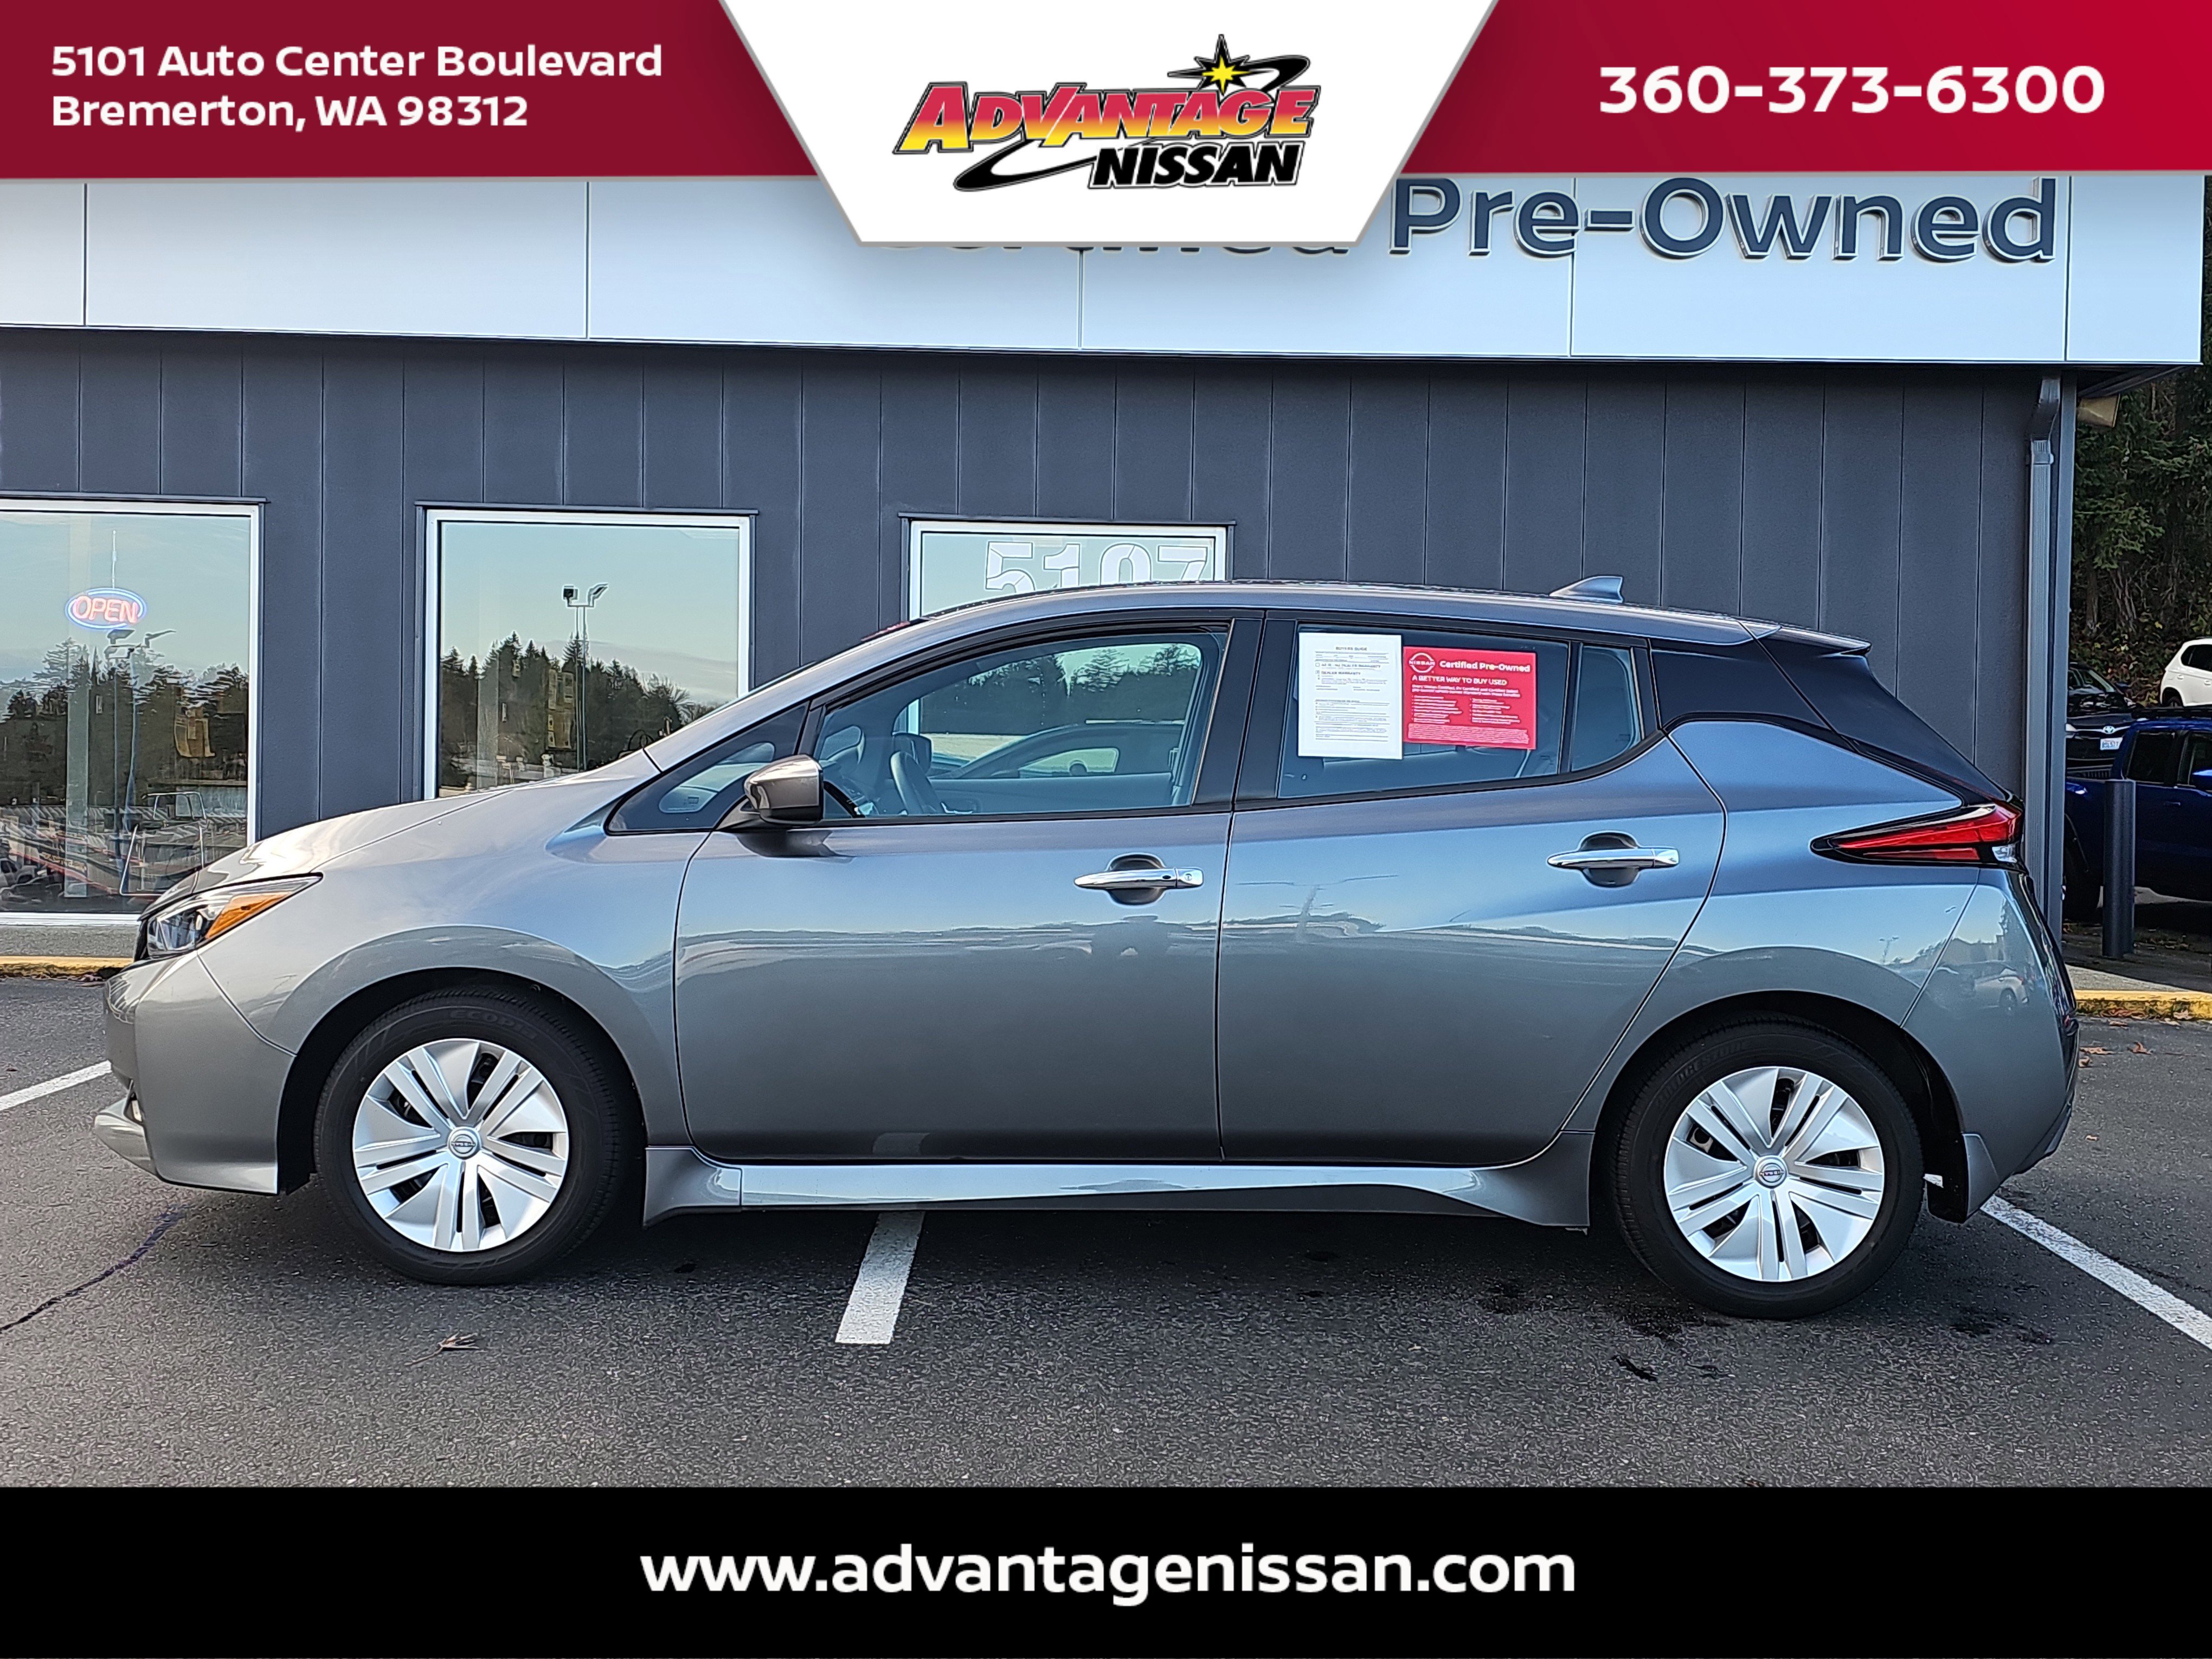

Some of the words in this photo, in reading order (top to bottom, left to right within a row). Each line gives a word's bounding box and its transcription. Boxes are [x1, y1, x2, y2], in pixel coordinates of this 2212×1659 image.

[1389, 178, 2056, 262] Pre-Owned
[986, 541, 1208, 593] 5107
[73, 596, 138, 623] OPEN
[1439, 660, 1478, 670] Certified
[1479, 663, 1531, 672] Pre-Owned
